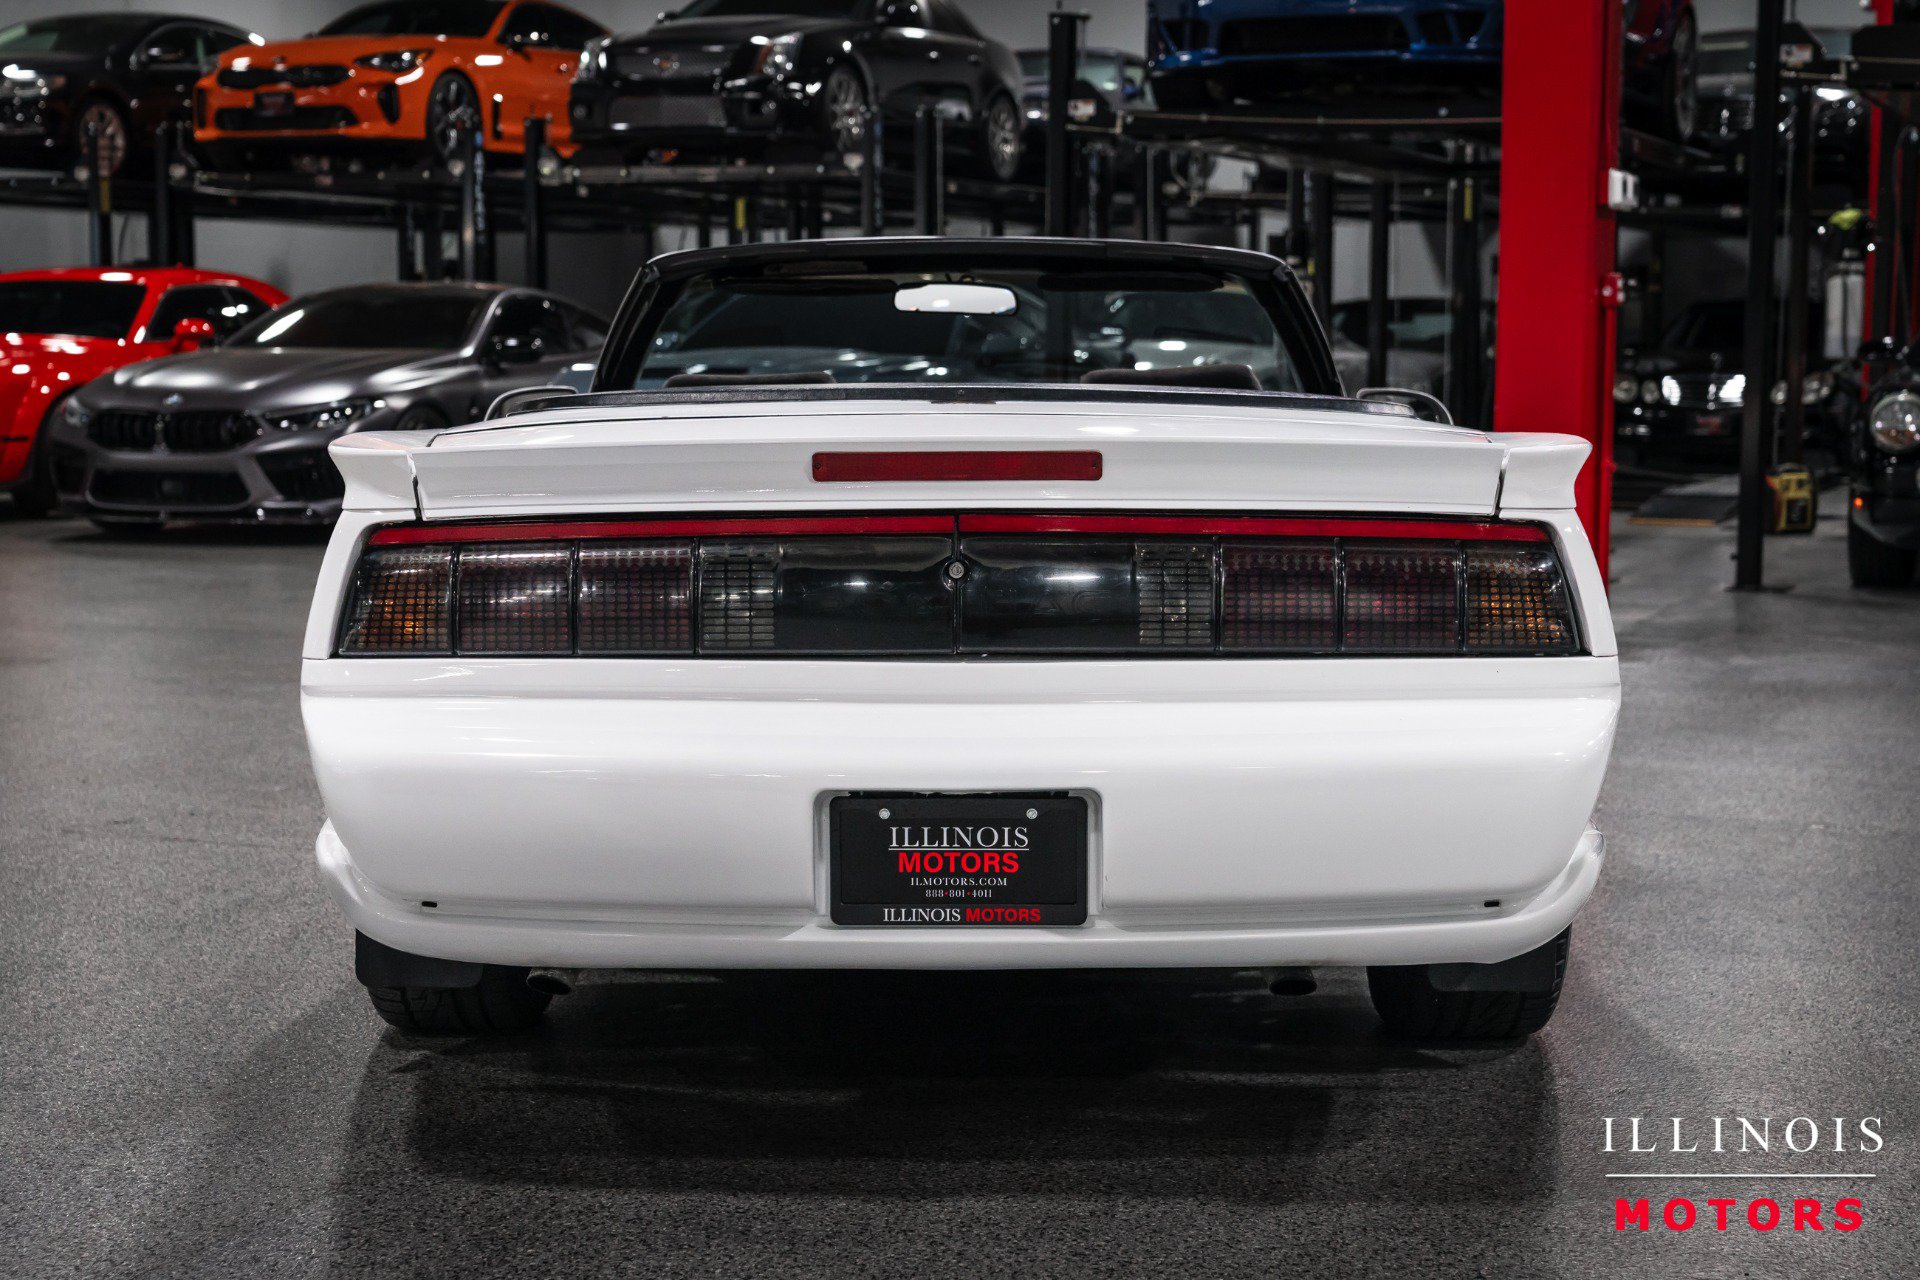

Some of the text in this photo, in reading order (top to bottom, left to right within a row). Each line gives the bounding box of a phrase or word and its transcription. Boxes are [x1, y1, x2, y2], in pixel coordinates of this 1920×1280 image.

[889, 826, 1029, 847] ILLINOIS
[898, 852, 1019, 873] MOTORS
[910, 877, 1007, 886] ILMOTORS.COM
[883, 908, 1041, 922] ILLINOIS MOTORS
